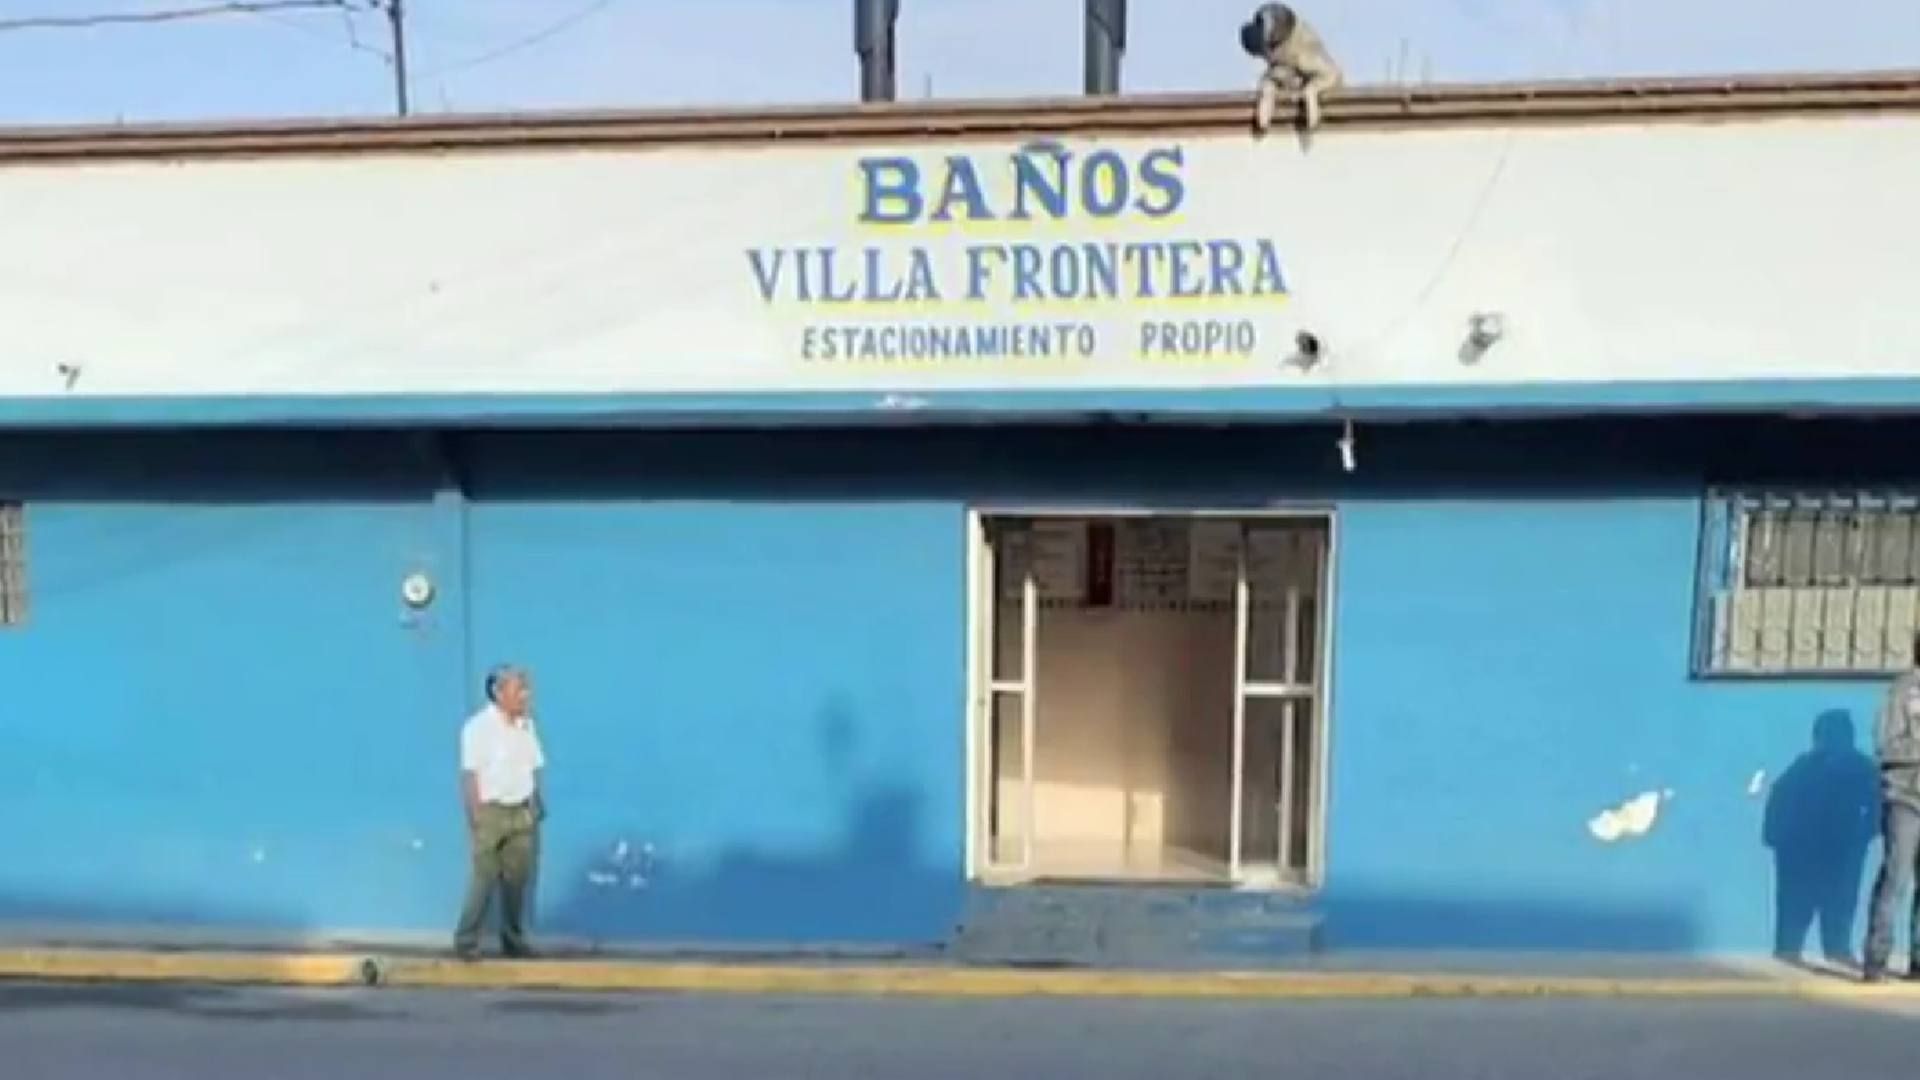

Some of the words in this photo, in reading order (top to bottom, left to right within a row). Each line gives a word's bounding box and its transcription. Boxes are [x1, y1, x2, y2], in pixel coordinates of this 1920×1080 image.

[857, 141, 1186, 225] BAÑOS
[746, 246, 940, 303] VILLA
[966, 237, 1290, 301] FRONTERA
[802, 321, 1096, 360] ESTACIONAMIENTO
[1140, 320, 1256, 356] PROPIO
